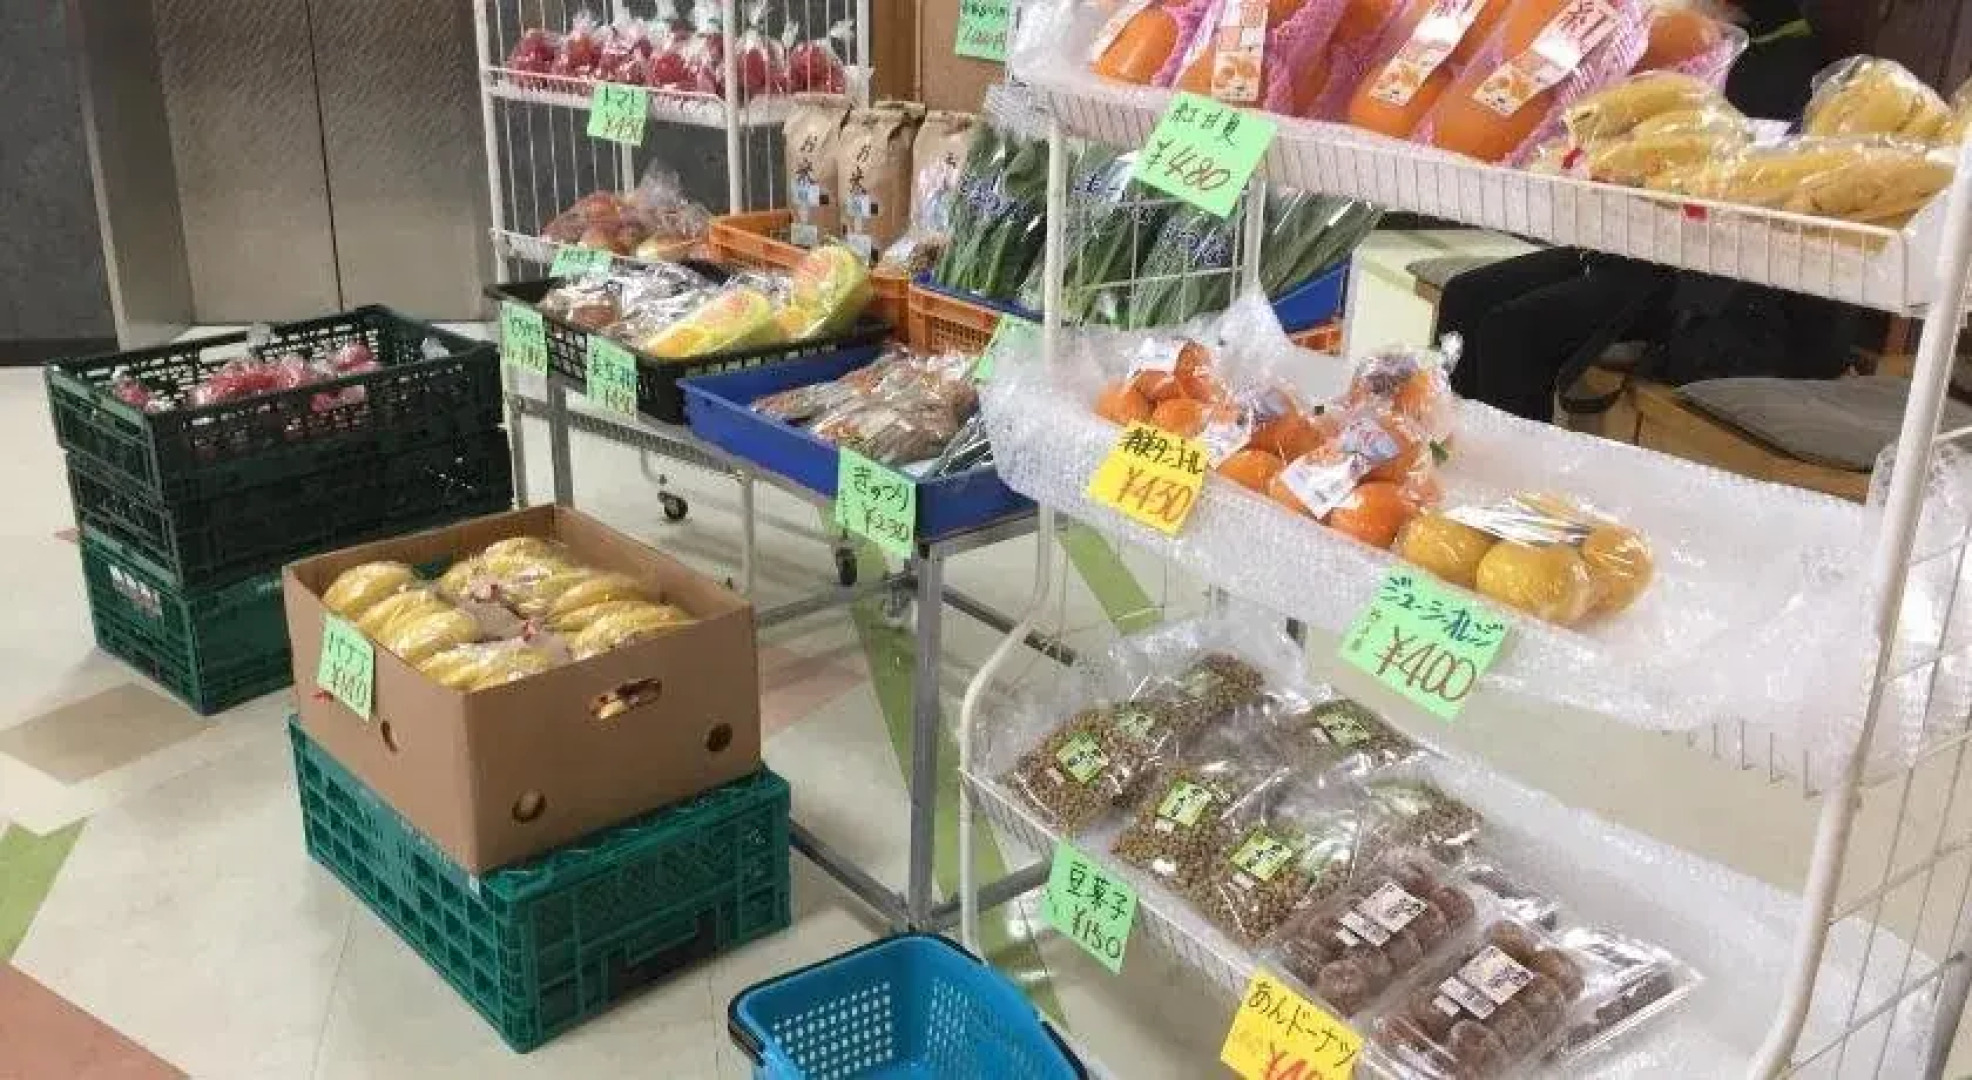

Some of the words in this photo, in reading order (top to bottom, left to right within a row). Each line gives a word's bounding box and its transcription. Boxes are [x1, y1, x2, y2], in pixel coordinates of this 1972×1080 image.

[1147, 138, 1231, 191] ¥480
[1117, 466, 1194, 523] ¥430
[1373, 624, 1477, 701] ¥400
[1066, 861, 1128, 920] 豆菓子
[1072, 903, 1121, 958] ¥150
[1248, 981, 1356, 1068] あんドーナツ
